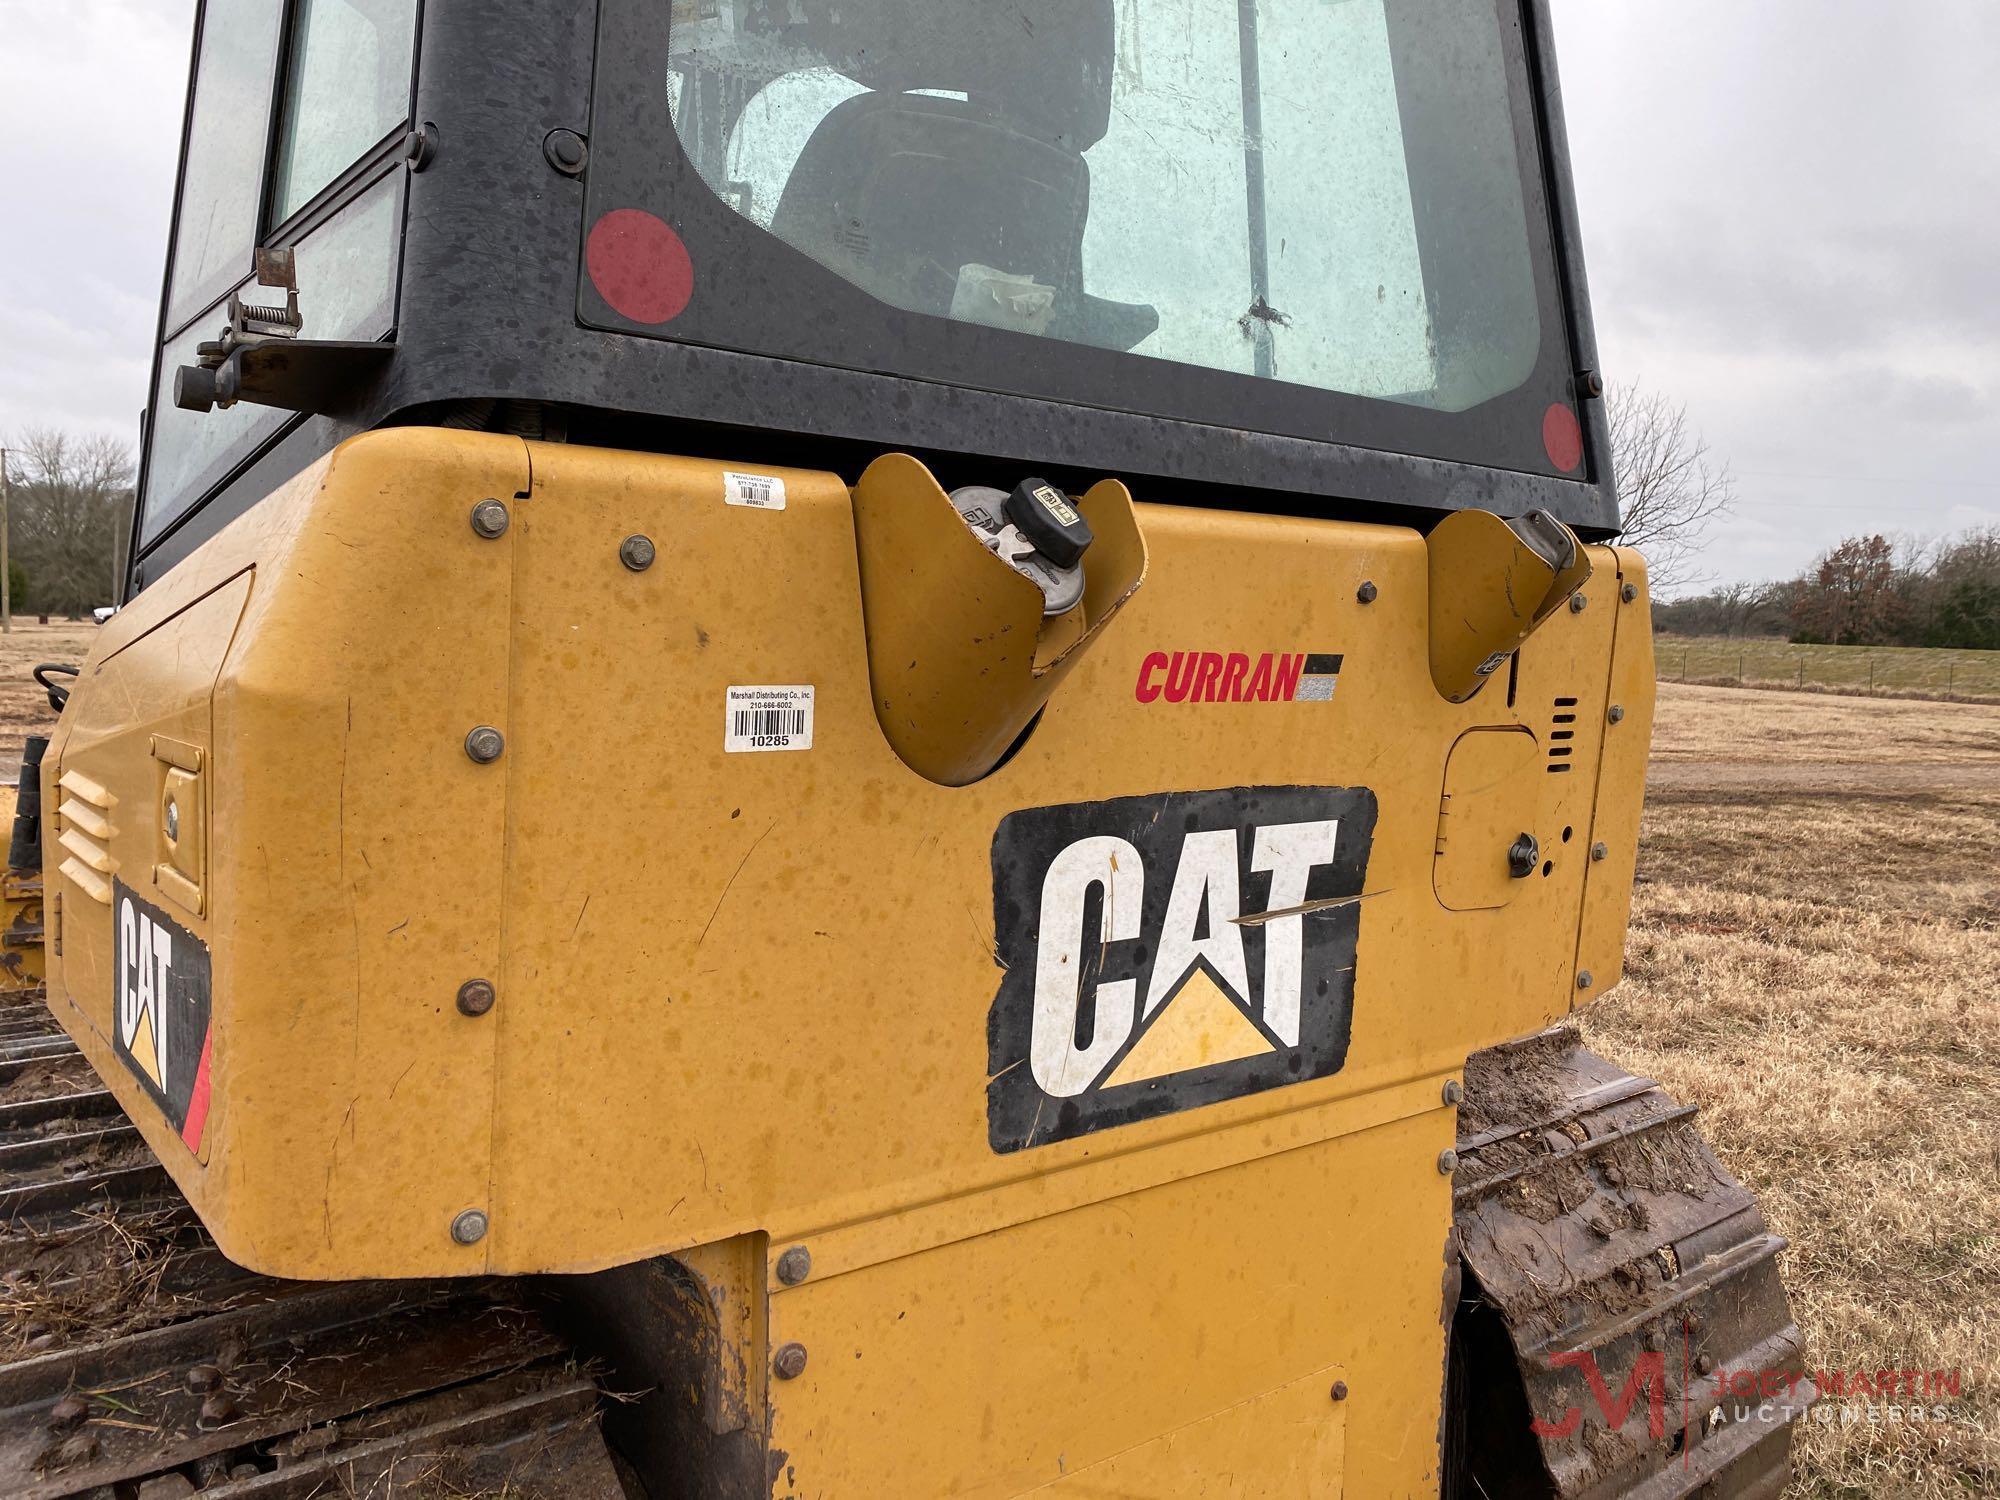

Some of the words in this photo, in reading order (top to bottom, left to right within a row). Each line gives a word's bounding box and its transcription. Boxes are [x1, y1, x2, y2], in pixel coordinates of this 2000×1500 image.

[1135, 652, 1304, 703] CURRAN
[731, 691, 755, 700] Marshall
[756, 691, 788, 700] Distributing
[789, 691, 801, 700] Co.,
[801, 691, 812, 699] Inc.
[750, 701, 793, 709] 210-666-6002
[750, 735, 790, 747] 10285
[1031, 820, 1338, 1098] CAT
[121, 897, 172, 1095] CAT
